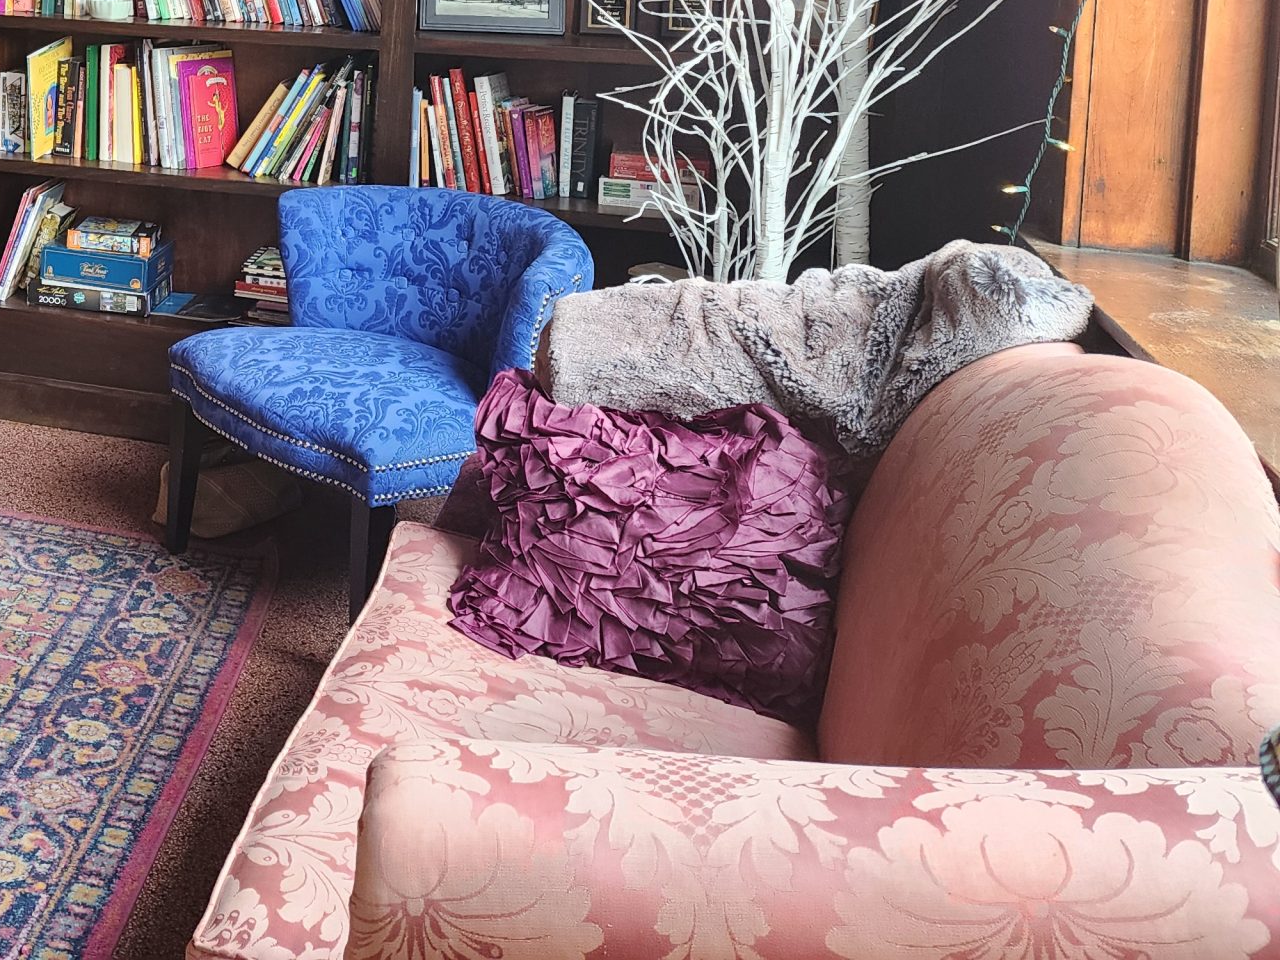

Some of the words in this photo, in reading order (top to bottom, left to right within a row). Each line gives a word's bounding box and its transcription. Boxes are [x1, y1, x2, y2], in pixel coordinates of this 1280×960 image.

[59, 77, 68, 93] Bear
[66, 85, 75, 100] Tom
[58, 105, 66, 119] The
[64, 101, 74, 124] Clancy
[481, 112, 492, 134] Recipe
[56, 121, 65, 144] Dragon
[199, 135, 212, 144] CAT
[571, 117, 589, 177] TRINITY
[38, 295, 61, 305] 2000
